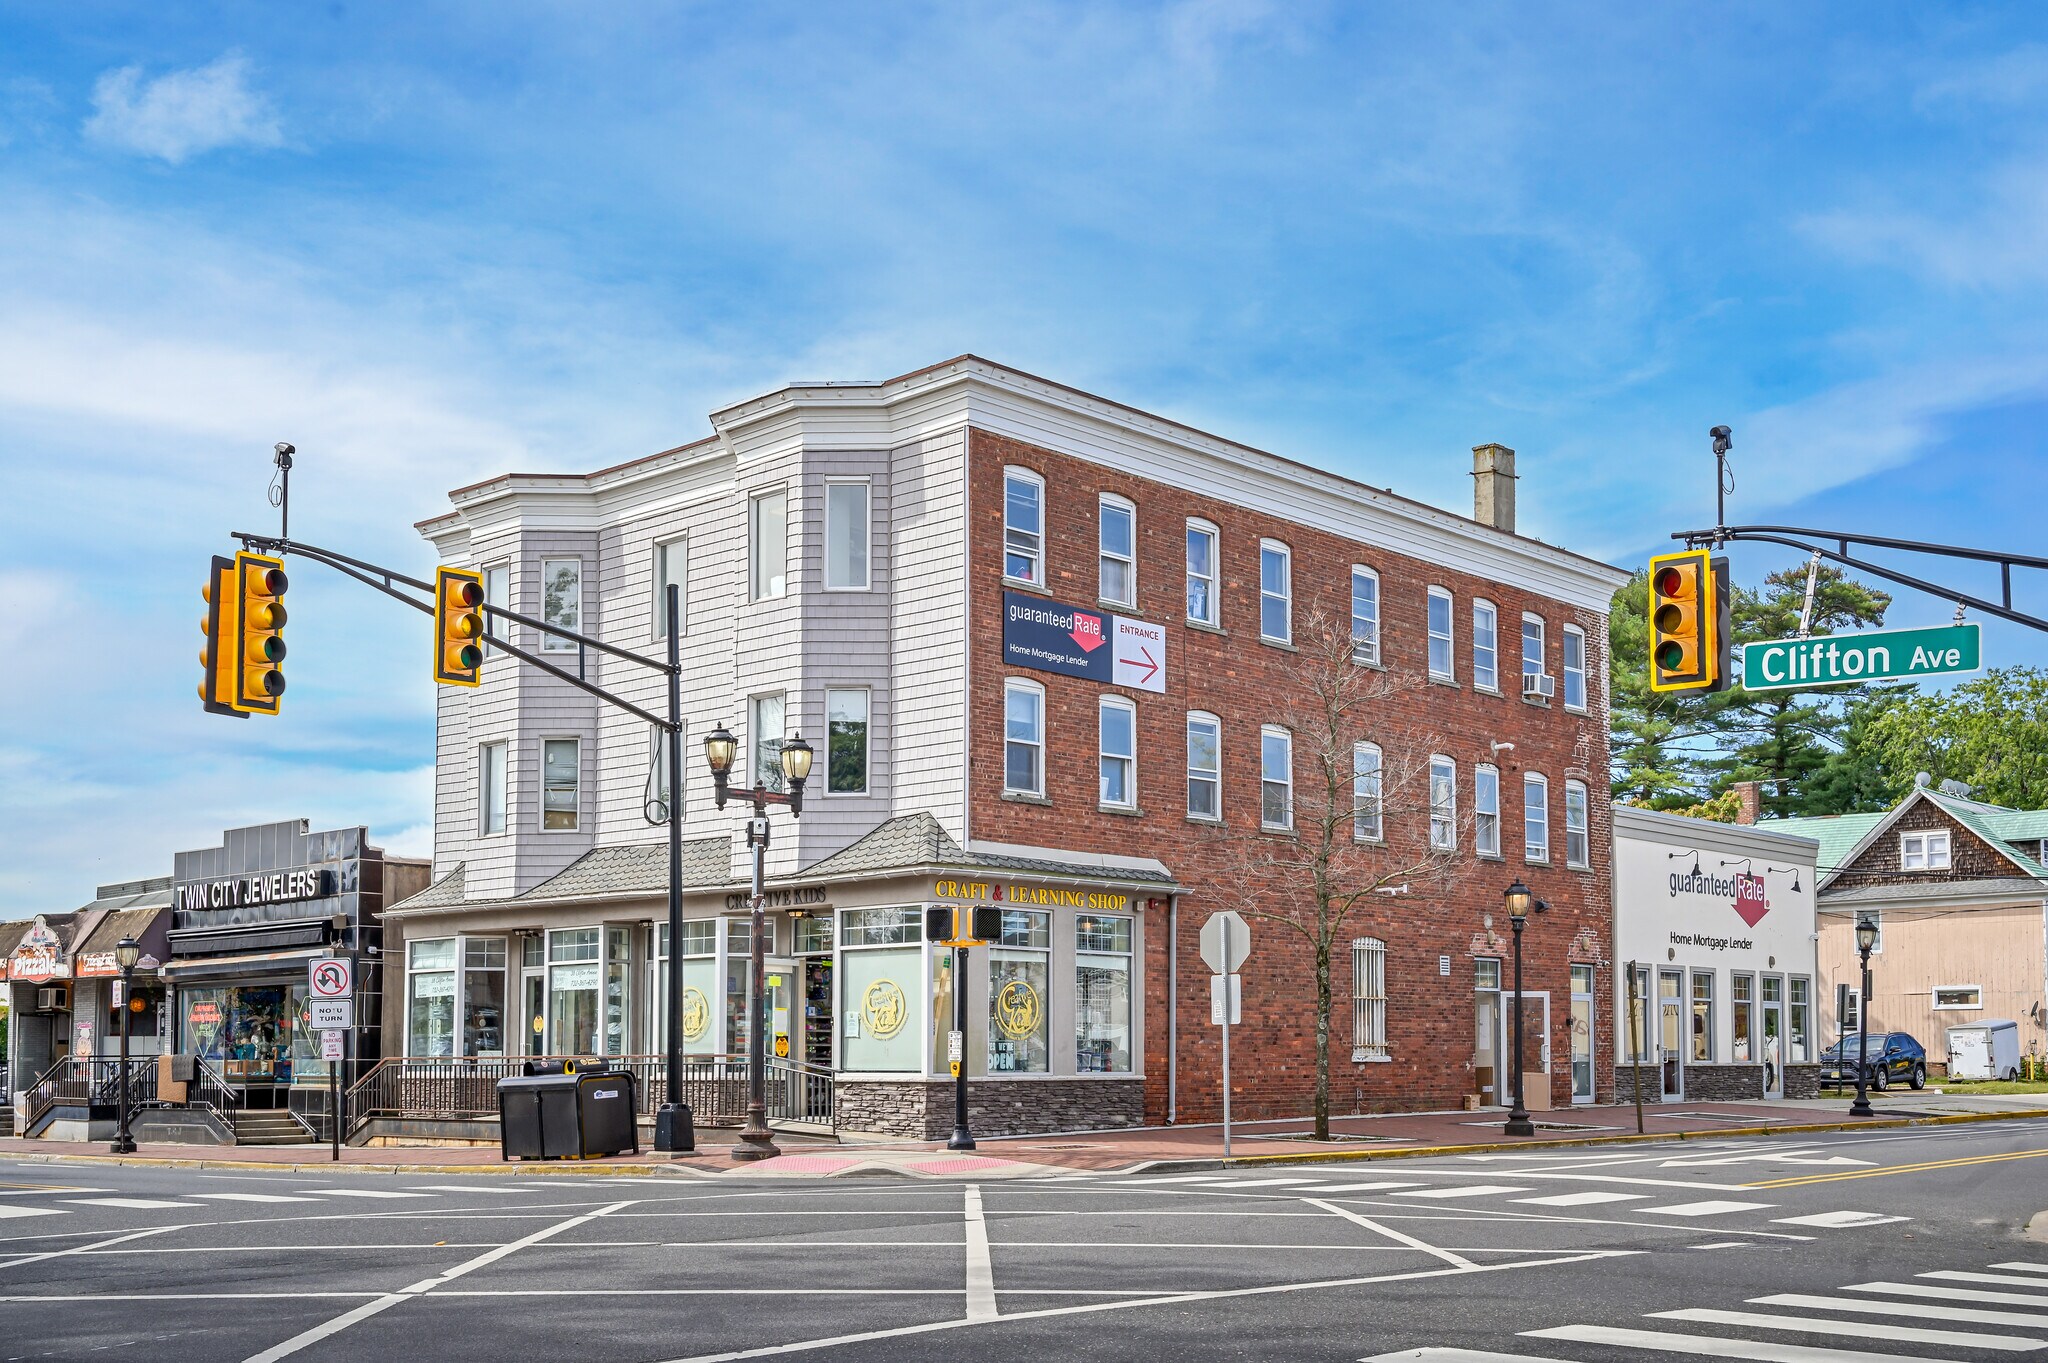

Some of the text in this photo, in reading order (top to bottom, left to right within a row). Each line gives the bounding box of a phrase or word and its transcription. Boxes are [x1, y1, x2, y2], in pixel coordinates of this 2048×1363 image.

[1009, 604, 1100, 636] guaranteed Rate
[1120, 624, 1160, 641] ENTRANCE
[1009, 643, 1089, 667] Home Mortgage Lender
[1761, 641, 1961, 683] Clifton Ave
[177, 869, 316, 910] TWIN CITY JEWELERS
[794, 886, 827, 905] KIDS
[935, 880, 1127, 911] CRAFT & LEARNING SHOP
[1669, 873, 1764, 902] guaranteed Rate
[1670, 931, 1753, 951] Home Mortgage Lender
[988, 1053, 1014, 1070] OPEN
